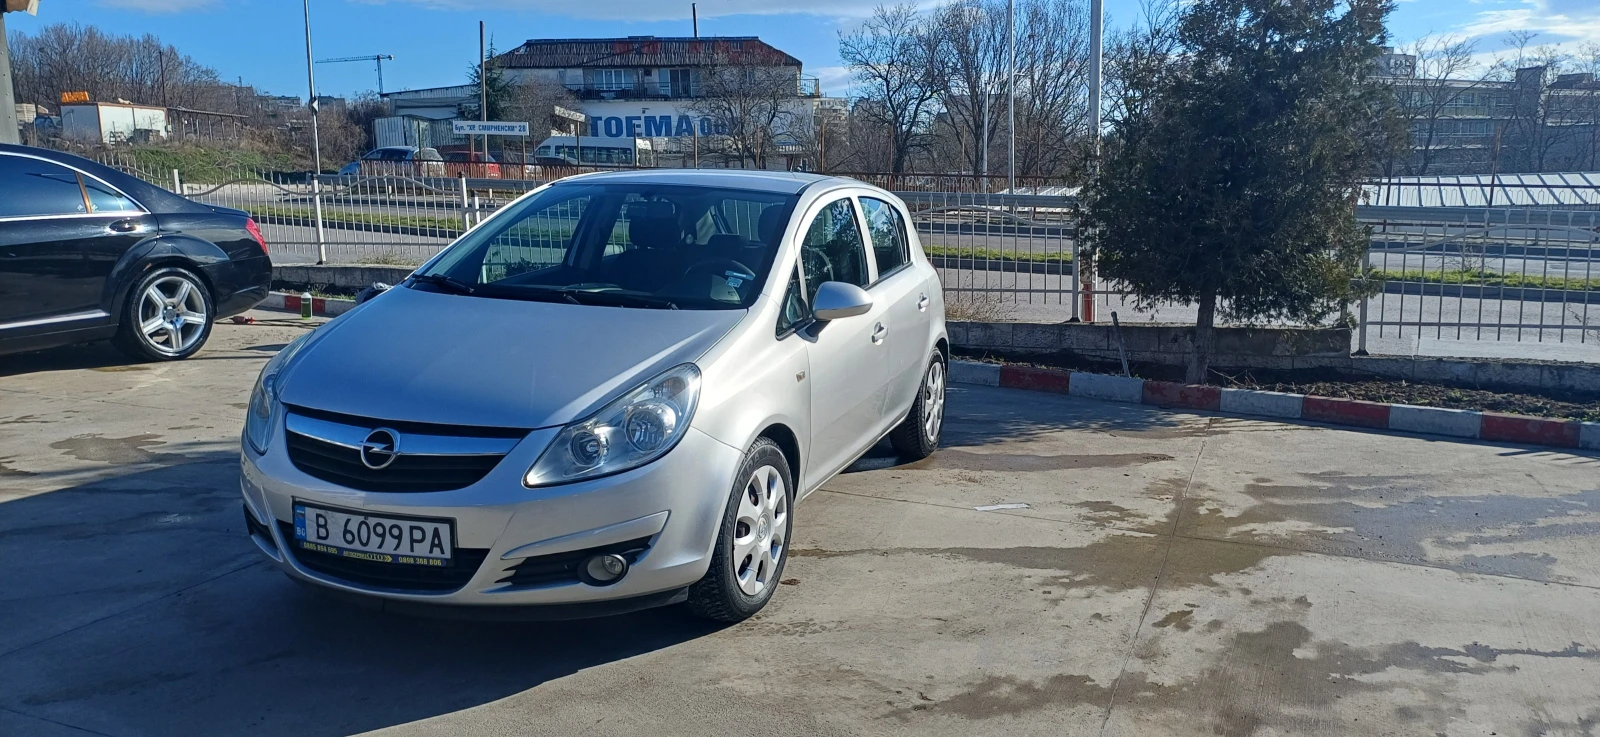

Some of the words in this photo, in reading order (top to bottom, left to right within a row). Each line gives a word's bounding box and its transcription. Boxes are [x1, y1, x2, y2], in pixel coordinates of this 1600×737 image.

[518, 124, 527, 132] 28
[296, 526, 306, 537] BG
[316, 513, 330, 540] B
